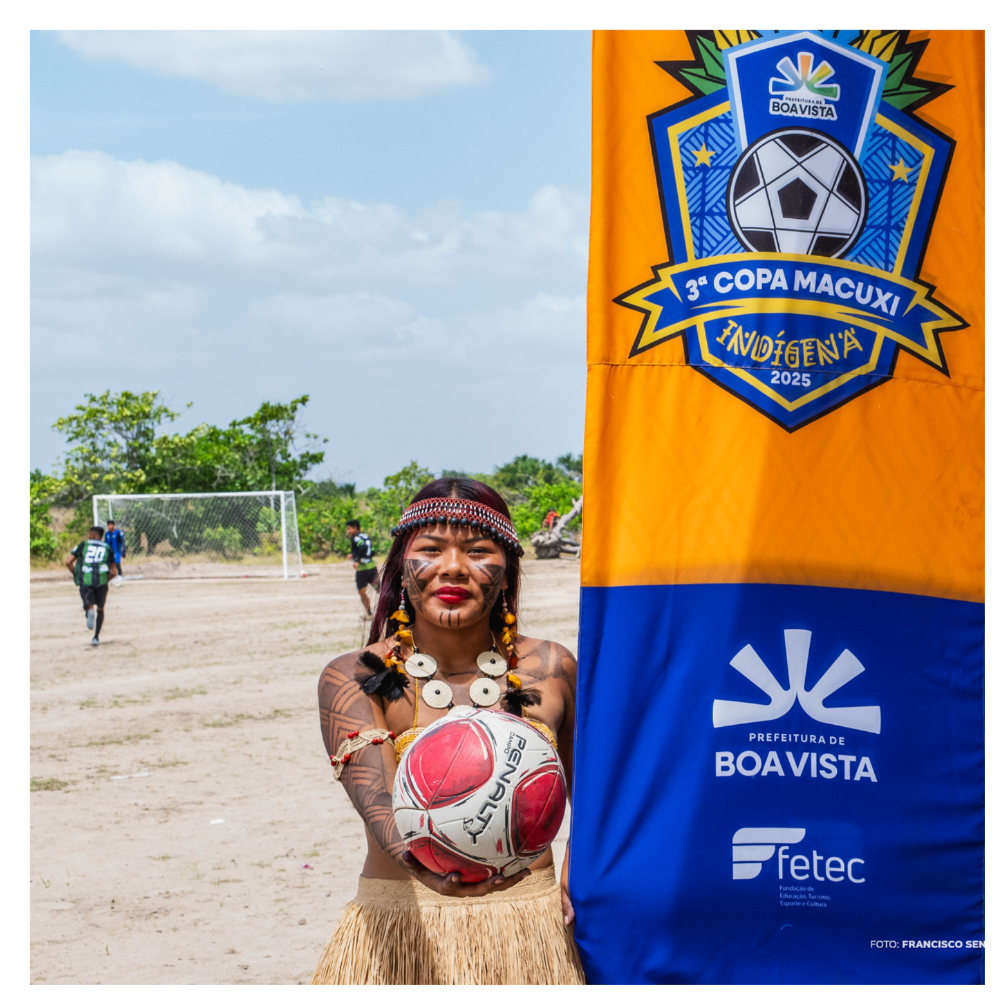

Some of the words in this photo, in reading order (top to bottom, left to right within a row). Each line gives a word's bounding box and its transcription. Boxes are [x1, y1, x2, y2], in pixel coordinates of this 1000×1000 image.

[713, 268, 788, 294] COPA
[794, 270, 900, 316] MACUXI
[770, 371, 811, 387] 2025
[85, 545, 106, 563] 20
[749, 732, 826, 744] PREFEITURA
[829, 736, 845, 746] DE
[468, 734, 527, 845] PENALTY
[778, 845, 866, 884] fetec
